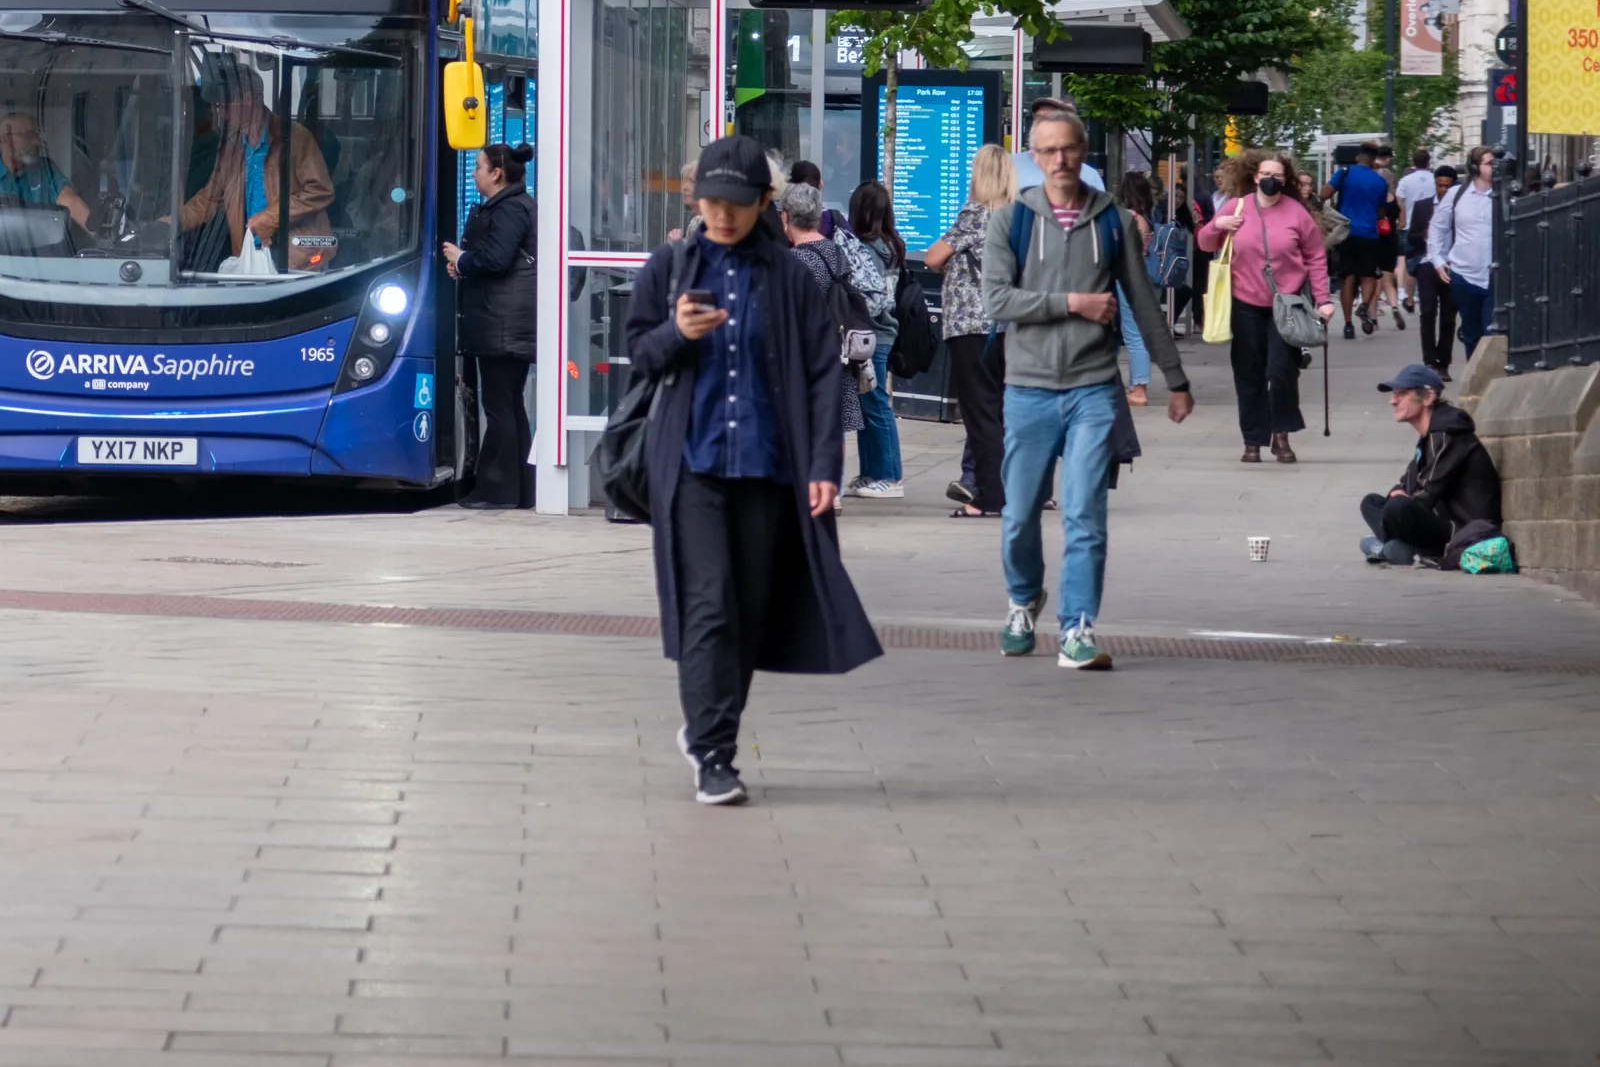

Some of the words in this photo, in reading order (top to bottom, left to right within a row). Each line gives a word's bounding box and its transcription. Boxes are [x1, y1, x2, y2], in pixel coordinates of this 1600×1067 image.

[1568, 28, 1599, 49] 350
[917, 88, 931, 96] Park
[932, 88, 946, 96] Row
[59, 354, 148, 375] ARRIVA
[151, 353, 255, 380] Sapphire
[300, 347, 335, 362] 1965
[94, 380, 104, 389] DB
[107, 380, 149, 390] company
[92, 441, 136, 459] YX17
[143, 440, 183, 459] NKP
